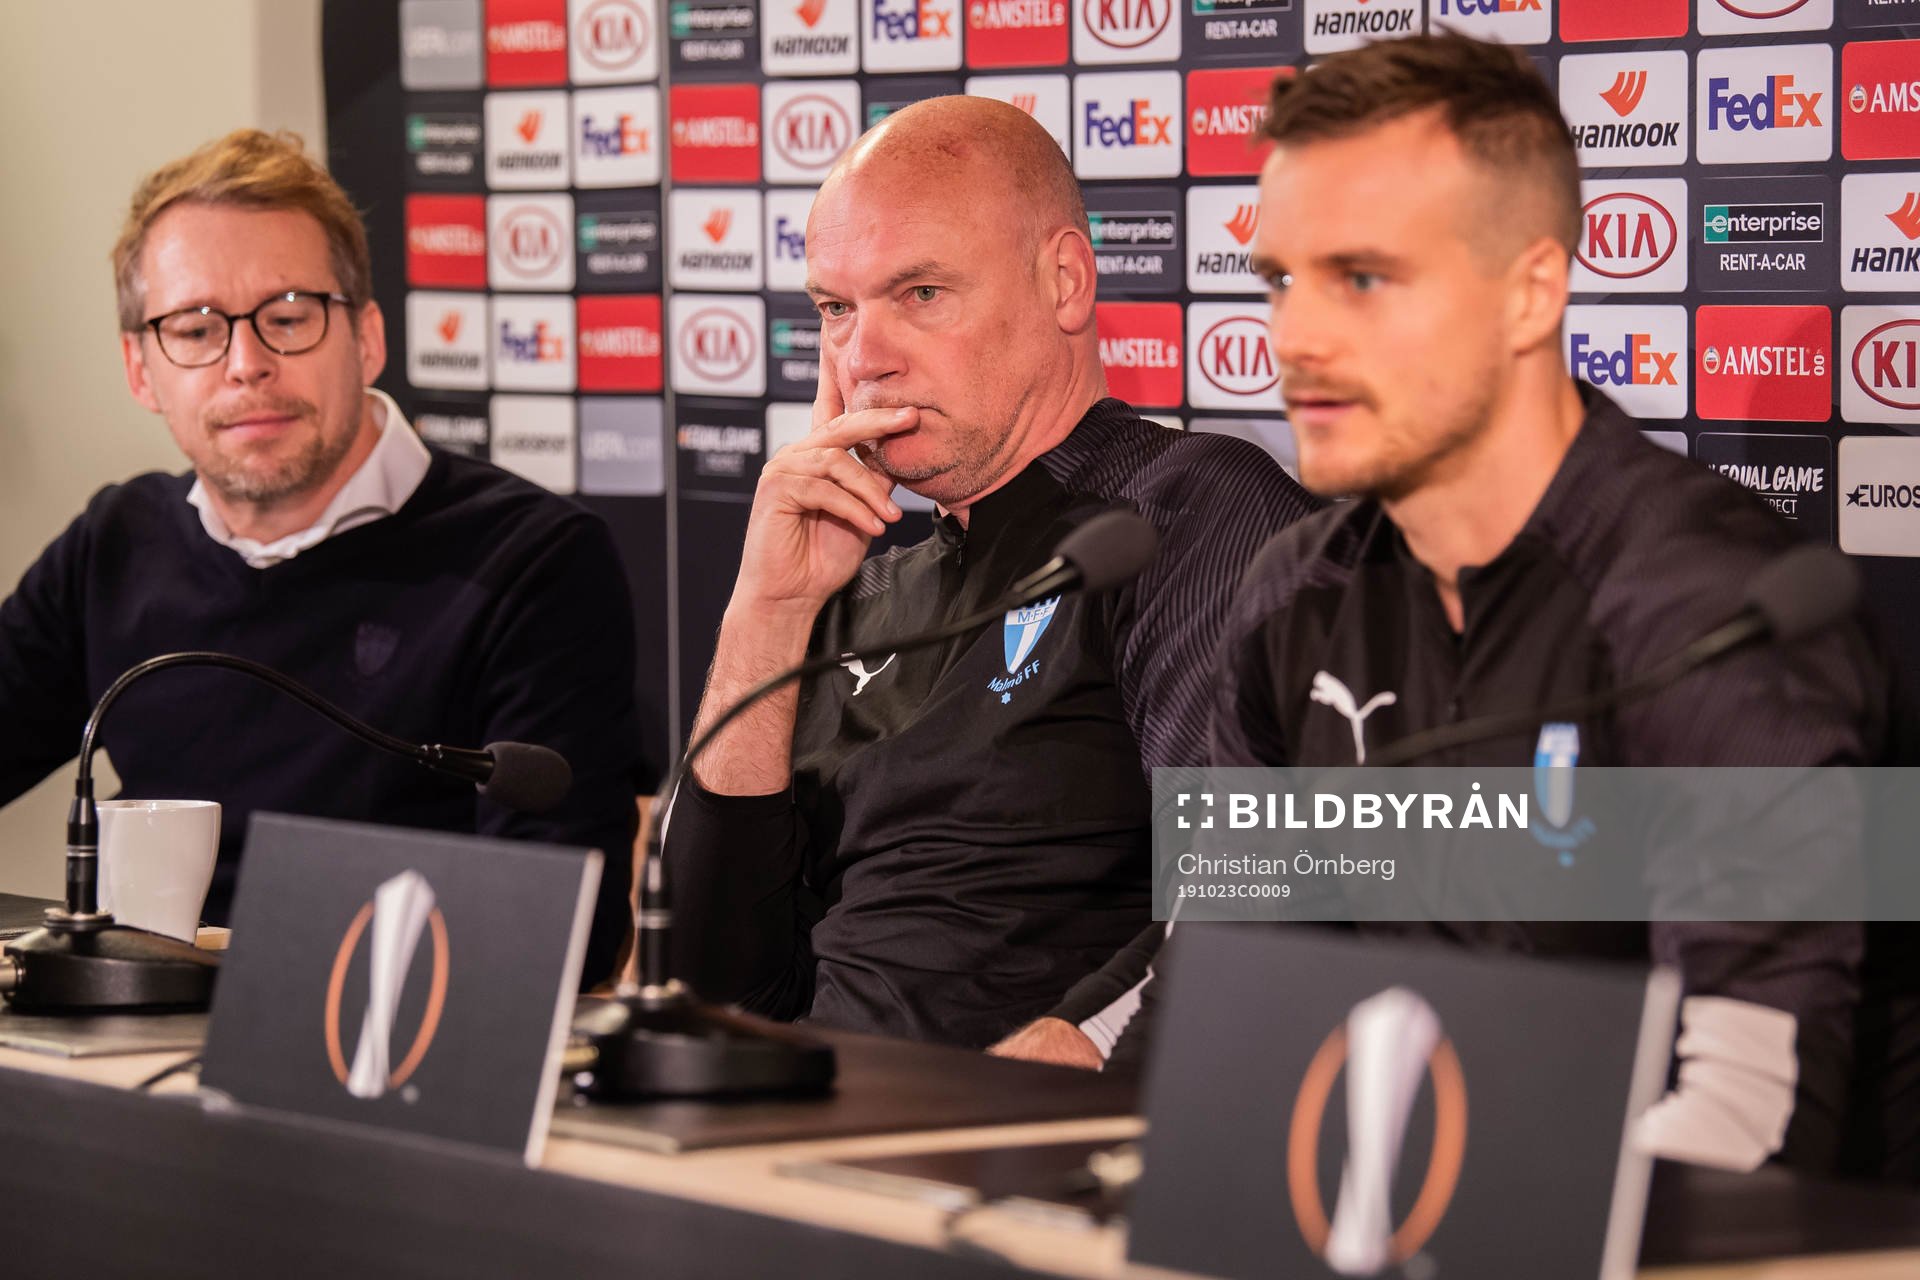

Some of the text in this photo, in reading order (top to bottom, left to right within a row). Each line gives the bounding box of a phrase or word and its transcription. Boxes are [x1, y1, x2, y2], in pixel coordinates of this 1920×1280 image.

[874, 0, 951, 39] FedEx
[1097, 0, 1155, 30] KIA
[1205, 19, 1278, 39] RENT-A-CAR
[1709, 75, 1823, 131] FedEx
[787, 113, 837, 150] KIA
[1085, 100, 1172, 146] FedEx
[1588, 213, 1658, 257] KIA
[1711, 211, 1820, 236] enterprise
[1720, 253, 1806, 271] RENT-A-CAR
[694, 328, 741, 362] KIA
[1100, 339, 1166, 367] AMSTEL
[1215, 336, 1273, 376] KIA
[1570, 334, 1679, 385] FedEx
[1722, 346, 1810, 376] AMSTEL
[987, 660, 1040, 692] Malmö FF
